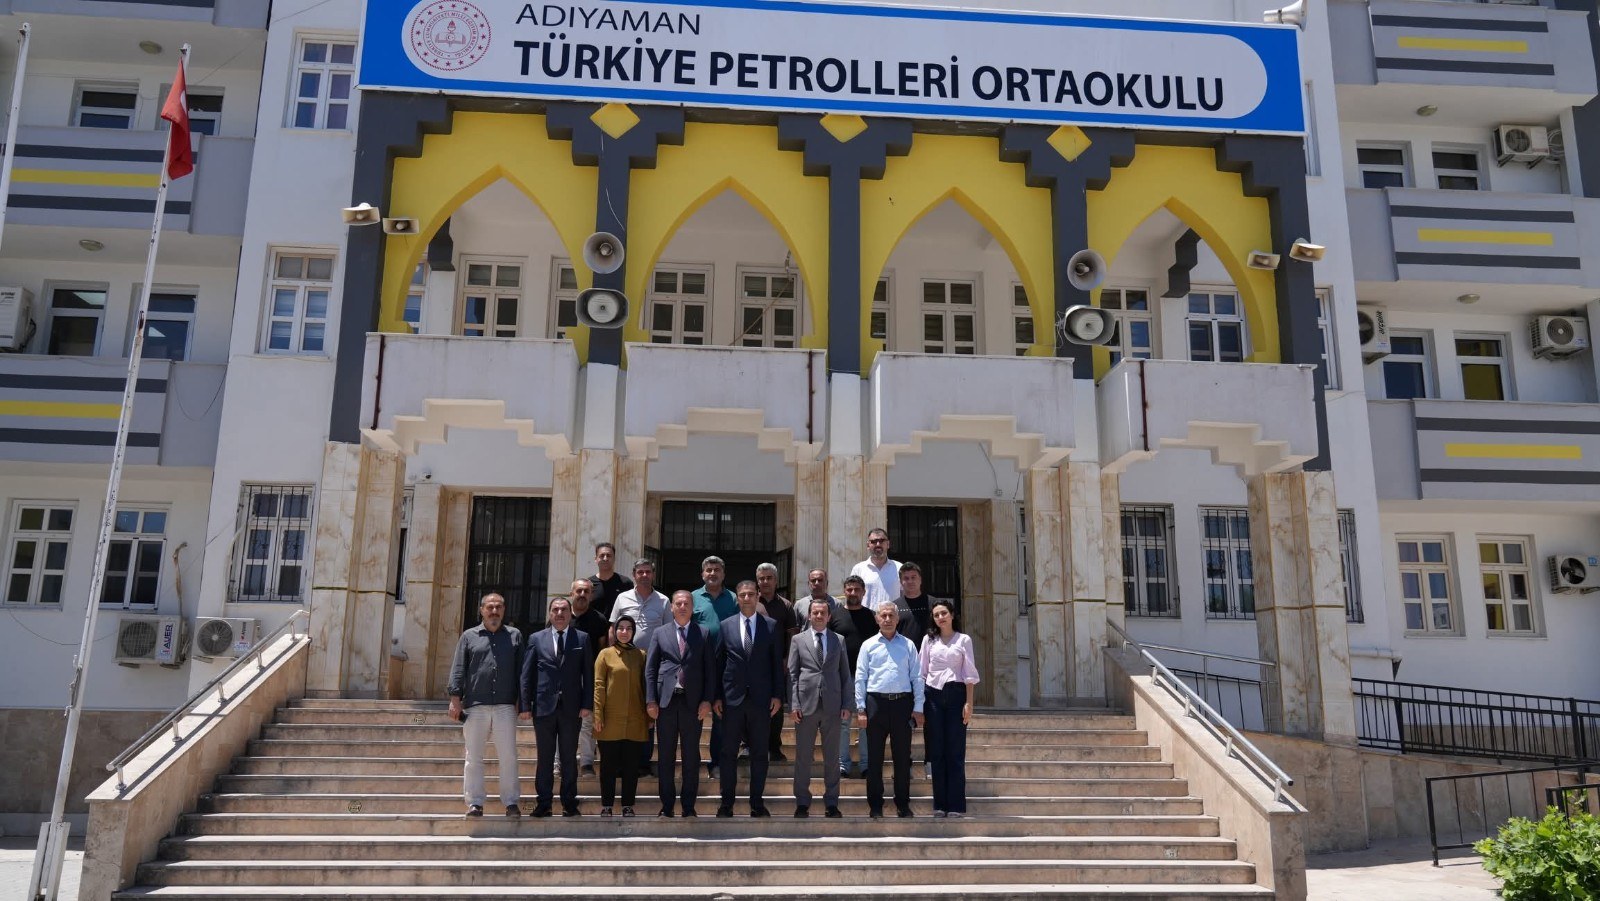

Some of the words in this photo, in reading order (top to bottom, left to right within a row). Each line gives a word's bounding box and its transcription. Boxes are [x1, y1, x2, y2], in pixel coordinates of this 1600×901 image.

[515, 4, 700, 35] ADIYAMAN
[513, 32, 696, 85] TÜRKİYE
[709, 51, 960, 99] PETROLLERİ
[971, 65, 1224, 112] ORTAOKULU
